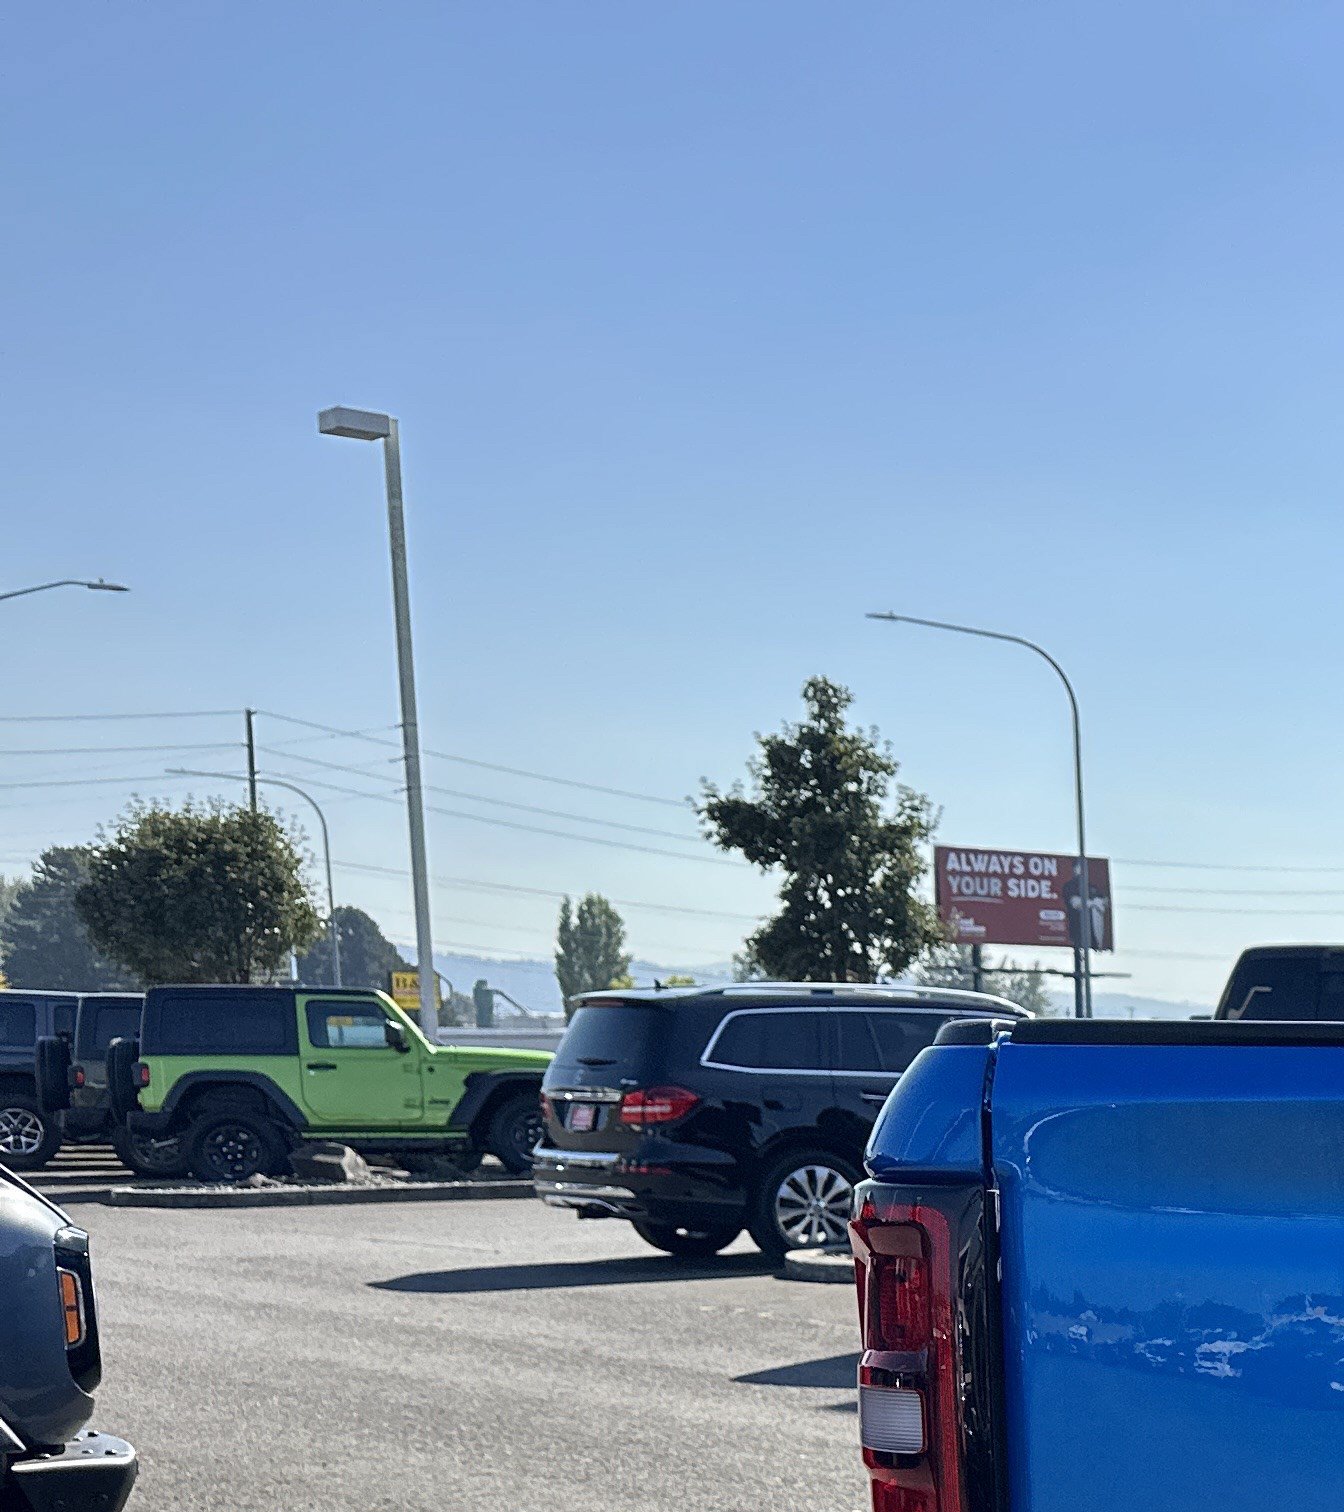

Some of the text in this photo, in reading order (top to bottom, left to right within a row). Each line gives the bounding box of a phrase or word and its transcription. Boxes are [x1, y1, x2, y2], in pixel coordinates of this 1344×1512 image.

[946, 851, 1058, 877] ALWAYS ON
[947, 874, 1059, 899] YOUR SIDE.
